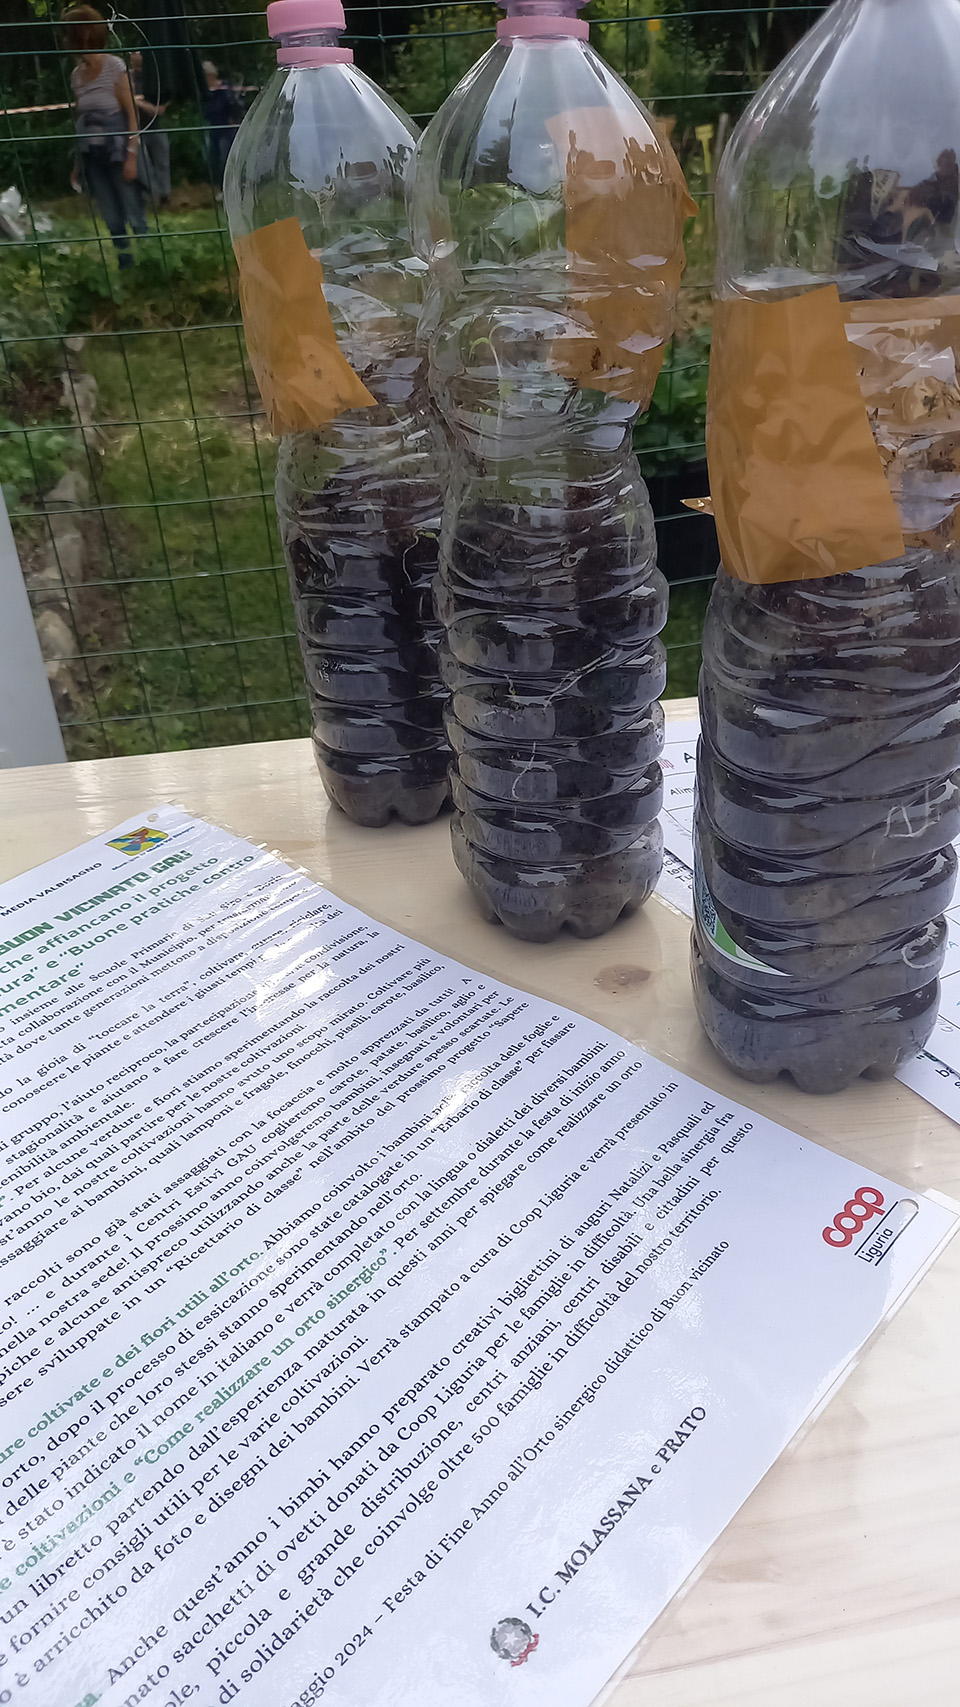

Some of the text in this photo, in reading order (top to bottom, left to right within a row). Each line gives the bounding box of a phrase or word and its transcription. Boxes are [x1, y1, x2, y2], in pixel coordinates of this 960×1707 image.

[0, 862, 102, 917] MEDIA VALBISAGNO
[0, 857, 218, 974] che affiancano il progetto
[53, 871, 152, 922] VICINATO
[149, 850, 193, 874] GAU
[0, 966, 38, 996] ura”
[46, 960, 59, 969] e
[129, 885, 201, 926] pratiche
[202, 855, 254, 885] contro
[9, 997, 59, 1025] insieme
[64, 983, 86, 996] alle
[88, 960, 128, 982] Scuole
[16, 1034, 47, 1054] dove
[48, 1015, 81, 1035] tante
[82, 974, 150, 1018] generazioni
[150, 950, 196, 977] mettono
[18, 924, 215, 1037] collaborazione con il Municipio, per
[2, 1073, 67, 1113] conoscere
[65, 1064, 82, 1074] le
[81, 1040, 122, 1067] piante
[132, 1001, 188, 1035] attendere
[194, 977, 226, 1000] giusti
[225, 958, 257, 979] tempi
[5, 1114, 85, 1165] stagionalità
[101, 1074, 148, 1105] aiutano
[163, 1048, 189, 1065] fare
[192, 1018, 240, 1048] crescere
[331, 940, 368, 962] natura,
[366, 931, 380, 939] la
[15, 1076, 32, 1086] la
[36, 1055, 69, 1077] gioia
[72, 1042, 87, 1054] di
[140, 1004, 156, 1012] la
[29, 1023, 307, 1203] bio, dai quali partire per le nostre coltivazioni.
[70, 1204, 85, 1218] ai
[83, 1165, 148, 1207] bambini,
[148, 1139, 182, 1165] quali
[179, 1104, 235, 1142] lamponi
[242, 1071, 289, 1100] fragole,
[286, 1038, 337, 1070] finocchi,
[335, 1014, 372, 1040] piselli,
[370, 992, 407, 1014] carote,
[401, 965, 445, 992] basilico,
[700, 1101, 716, 1115] ed
[59, 1102, 135, 1150] ambientale.
[651, 1154, 662, 1162] e
[656, 1113, 702, 1154] Pasquali
[38, 1311, 121, 1376] sviluppate
[122, 1296, 142, 1310] in
[376, 1101, 397, 1117] del
[396, 1064, 446, 1103] prossimo
[446, 1031, 491, 1065] progetto
[607, 1160, 653, 1201] Natalizi
[559, 1235, 576, 1250] di
[574, 1199, 613, 1237] auguri
[822, 1187, 885, 1248] coop
[858, 1228, 893, 1263] Liguria
[497, 1248, 561, 1306] bigliettini
[28, 1535, 102, 1597] libretto
[105, 1463, 185, 1537] partendo
[303, 1303, 370, 1361] maturata
[366, 1288, 387, 1303] in
[386, 1248, 428, 1287] questi
[427, 1223, 458, 1251] anni
[456, 1205, 478, 1228] per
[479, 1163, 527, 1206] spiegare
[526, 1137, 557, 1163] come
[556, 1093, 606, 1137] realizzare
[604, 1080, 622, 1093] un
[620, 1061, 643, 1080] orto
[452, 1305, 502, 1355] creativi
[6, 1478, 50, 1516] delle
[50, 1431, 107, 1482] piante
[109, 1405, 139, 1431] che
[135, 1376, 173, 1406] loro
[174, 1337, 219, 1377] stessi
[218, 1298, 268, 1341] stanno
[269, 1216, 368, 1299] sperimentando
[381, 1357, 451, 1425] preparato
[219, 1190, 722, 1704] di solidarietà che coinvolge oltre 500 famiglie in difficoltà del nostro territorio.
[327, 1424, 380, 1471] hanno
[334, 1625, 373, 1667] 2024
[381, 1570, 427, 1613] Festa
[424, 1549, 443, 1569] di
[437, 1520, 473, 1553] Fine
[470, 1481, 509, 1521] Anno
[554, 1374, 607, 1431] sinergico
[604, 1323, 654, 1374] didattico
[650, 1307, 667, 1323] di
[659, 1282, 693, 1311] Buon
[688, 1241, 729, 1280] vicinato
[267, 1516, 281, 1529] i
[277, 1468, 331, 1518] bimbi
[525, 1406, 706, 1619] I.C. MOLASSANA e PRATO
[107, 1625, 168, 1685] Anche
